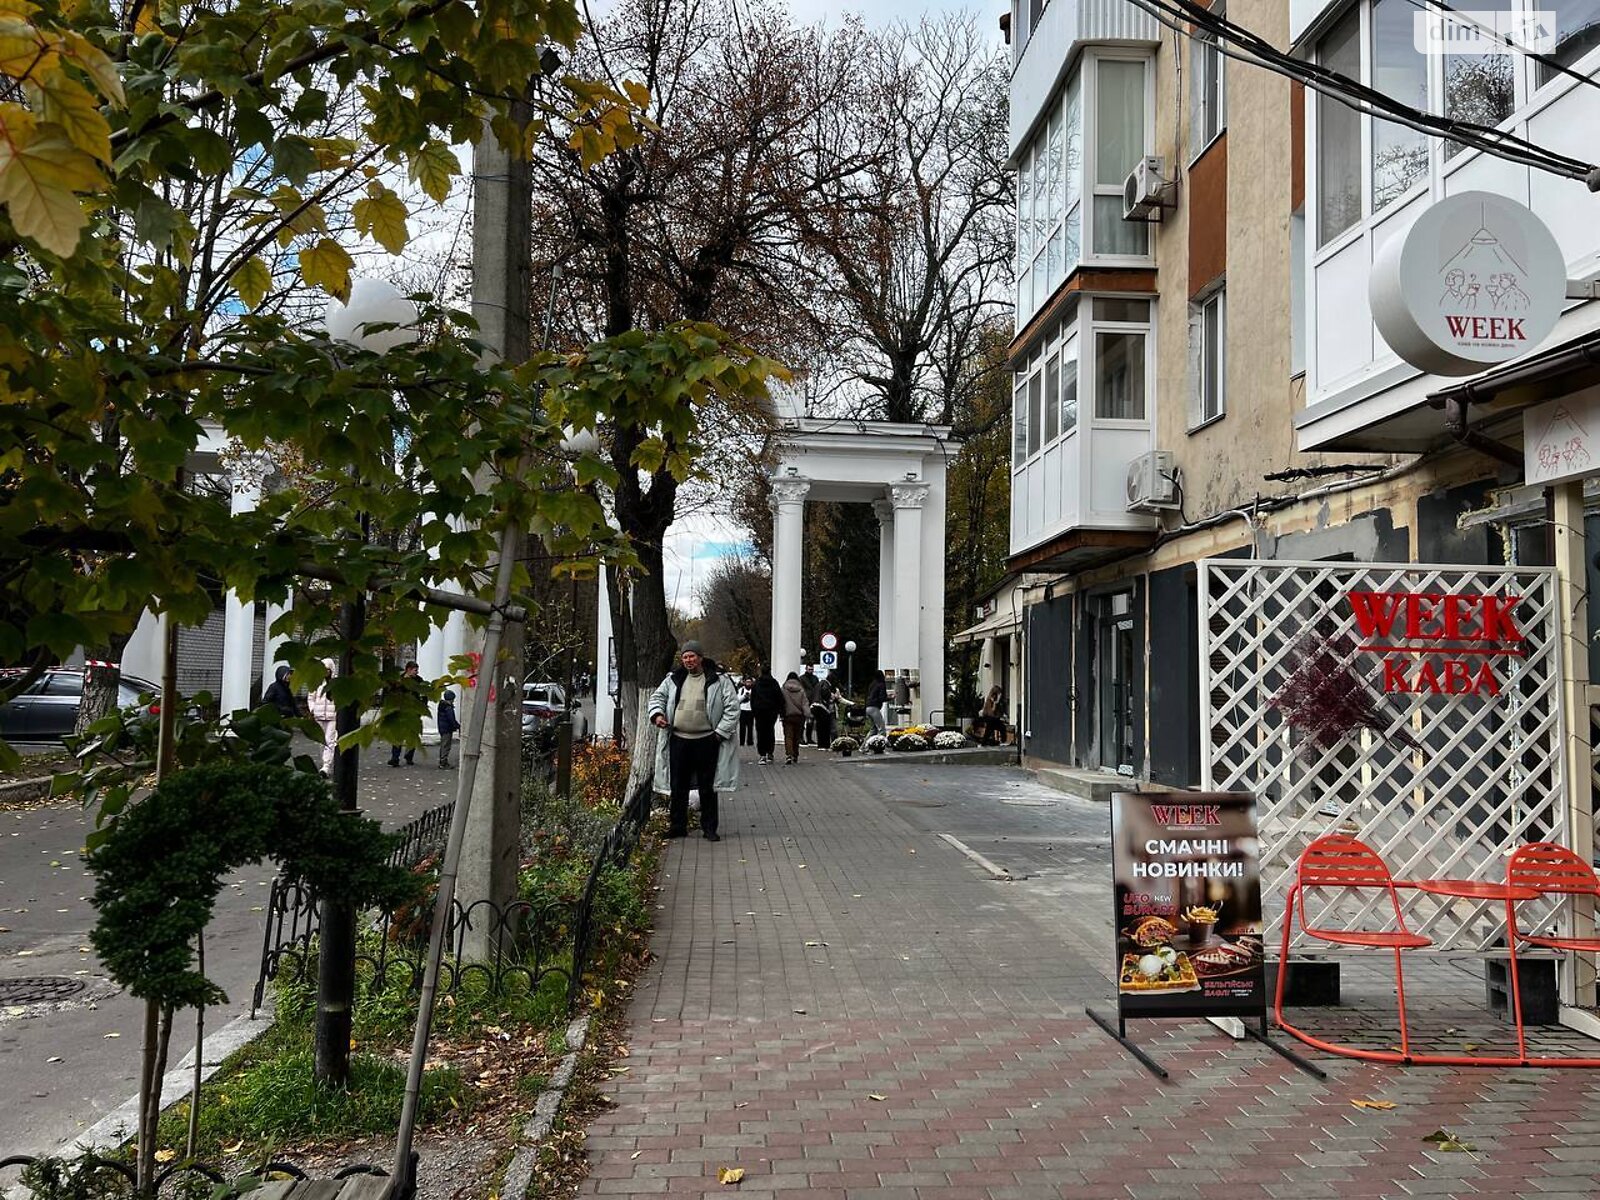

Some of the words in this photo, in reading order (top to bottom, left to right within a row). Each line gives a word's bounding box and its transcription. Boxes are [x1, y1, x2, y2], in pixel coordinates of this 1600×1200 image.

[1445, 315, 1527, 340] WEEK
[1346, 591, 1525, 642] WEEK
[1384, 659, 1502, 697] КАВА
[1151, 804, 1221, 826] WEEK
[1144, 839, 1229, 855] СМАЧНІ
[1132, 862, 1244, 878] НОВИНКИ!
